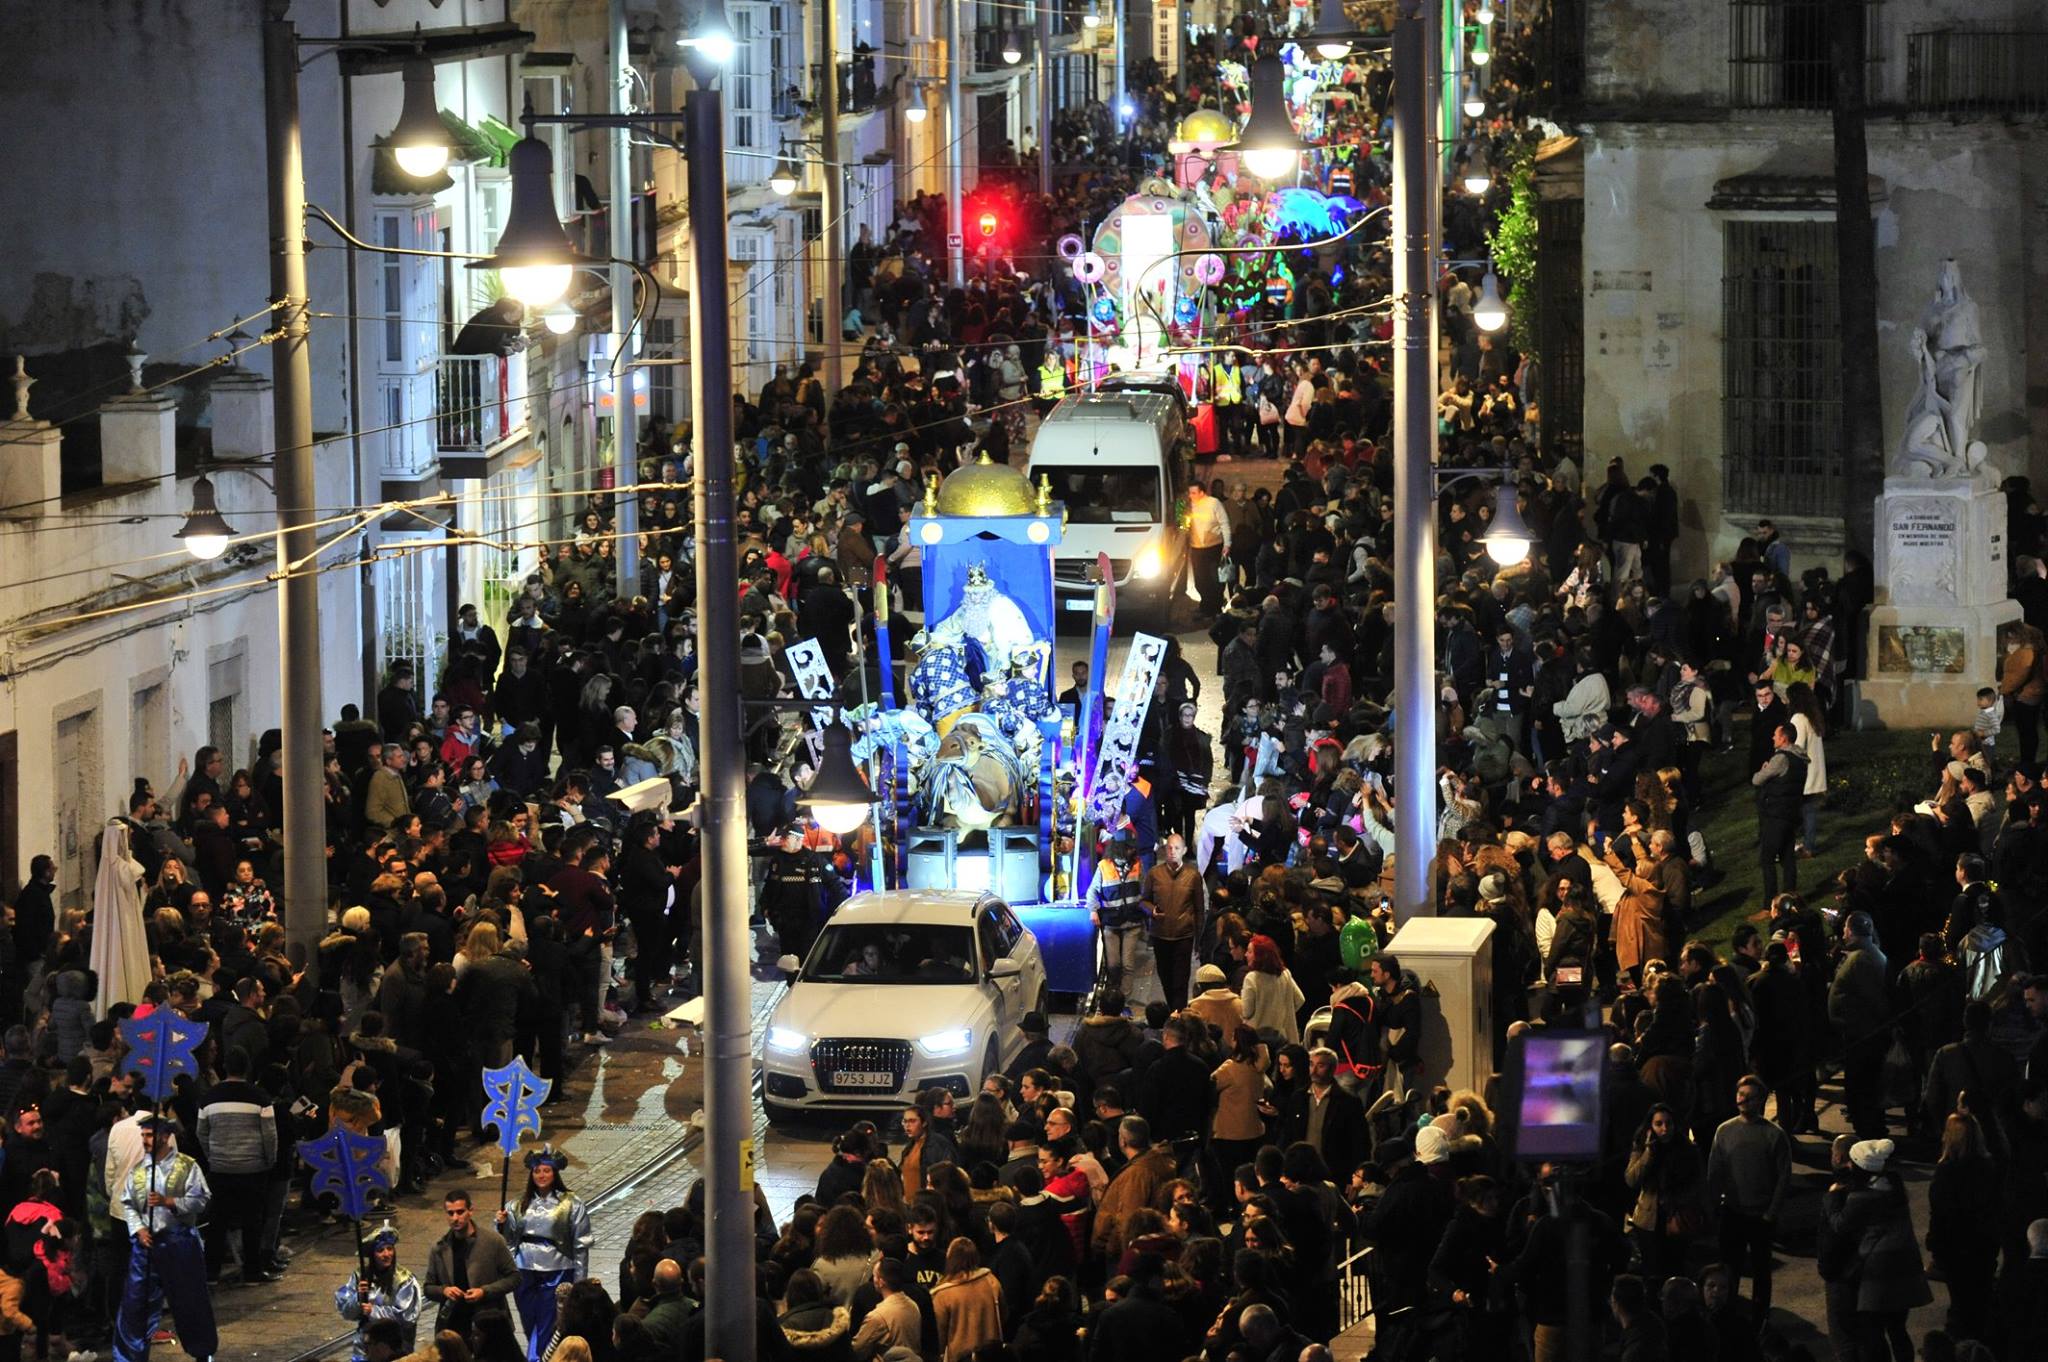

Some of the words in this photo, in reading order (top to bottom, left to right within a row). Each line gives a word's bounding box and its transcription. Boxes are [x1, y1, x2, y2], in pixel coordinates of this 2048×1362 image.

[1893, 522, 1909, 531] SAN
[1911, 522, 1955, 531] FERNANDO
[835, 1073, 865, 1085] 9753
[868, 1073, 890, 1085] JJZ
